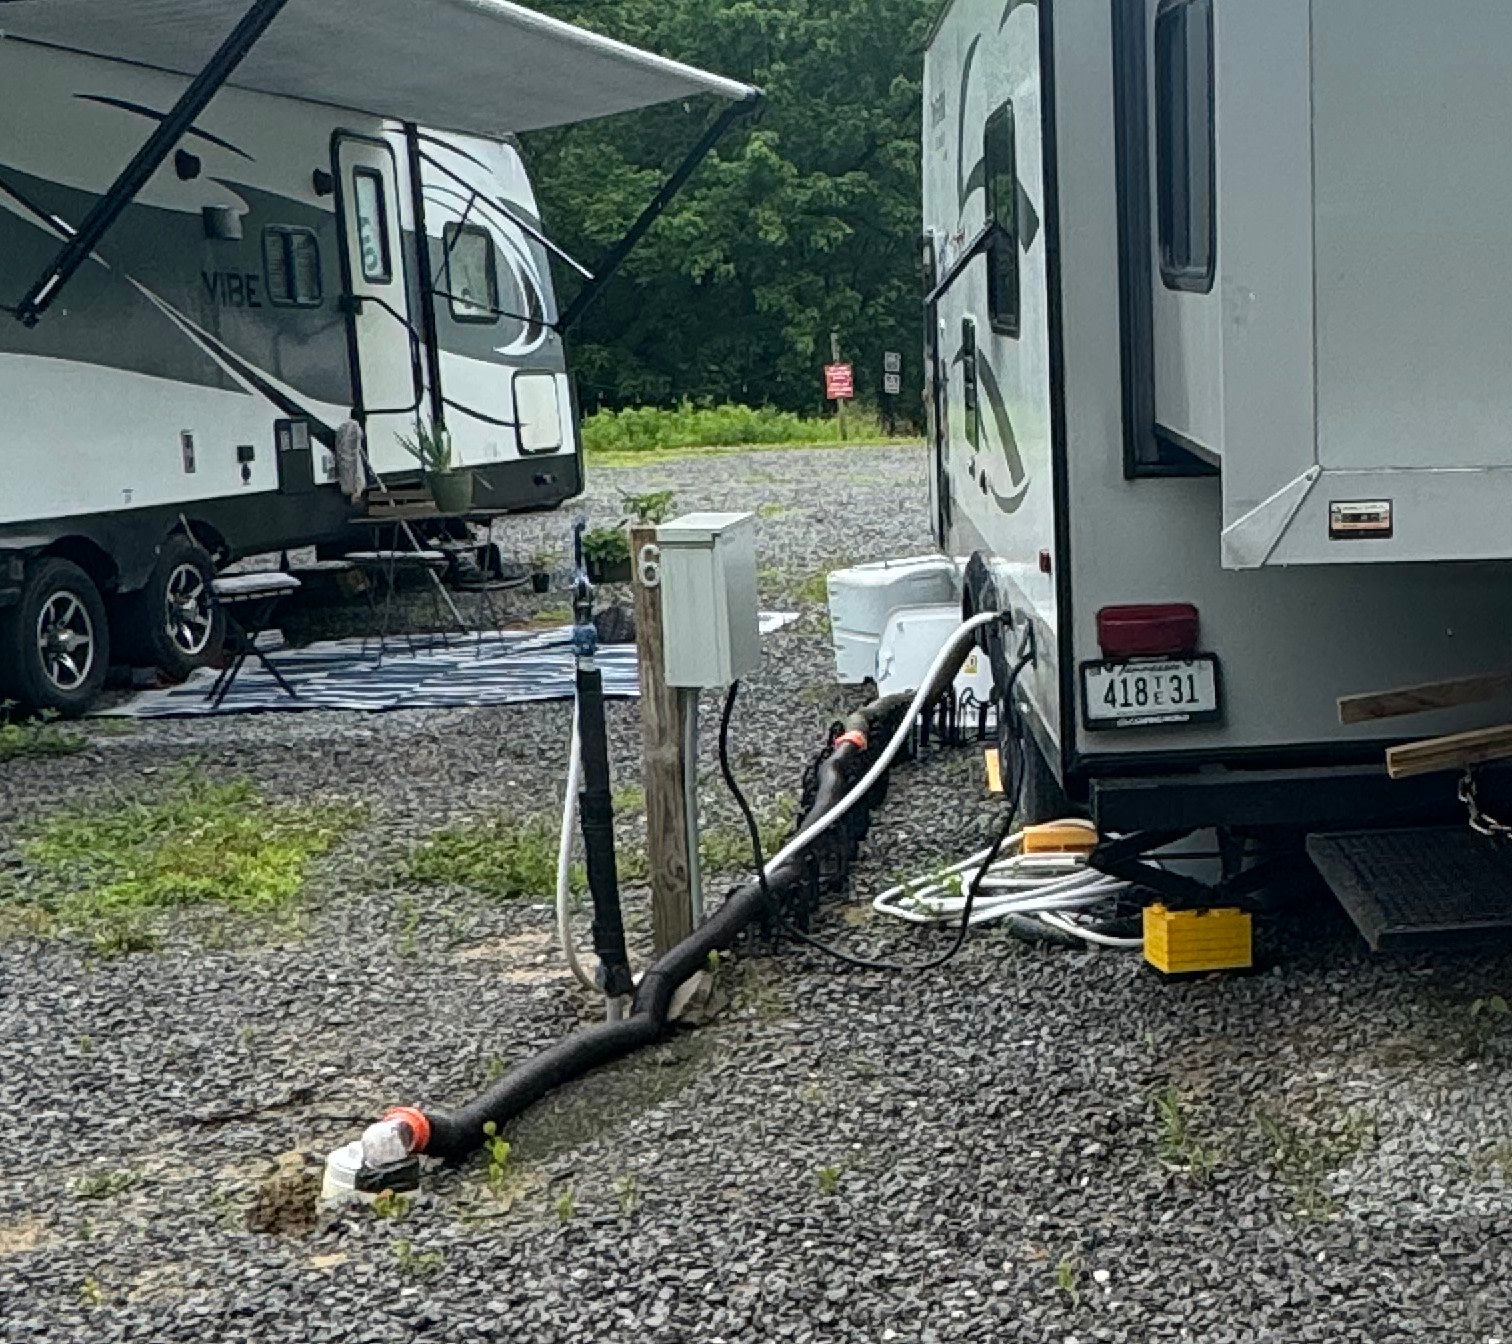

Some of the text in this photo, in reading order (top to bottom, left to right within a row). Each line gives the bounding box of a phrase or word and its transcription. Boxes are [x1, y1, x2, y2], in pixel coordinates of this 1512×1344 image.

[201, 270, 262, 308] VIBE
[638, 543, 661, 588] 6
[1103, 676, 1149, 709] 418
[1168, 672, 1200, 704] 31
